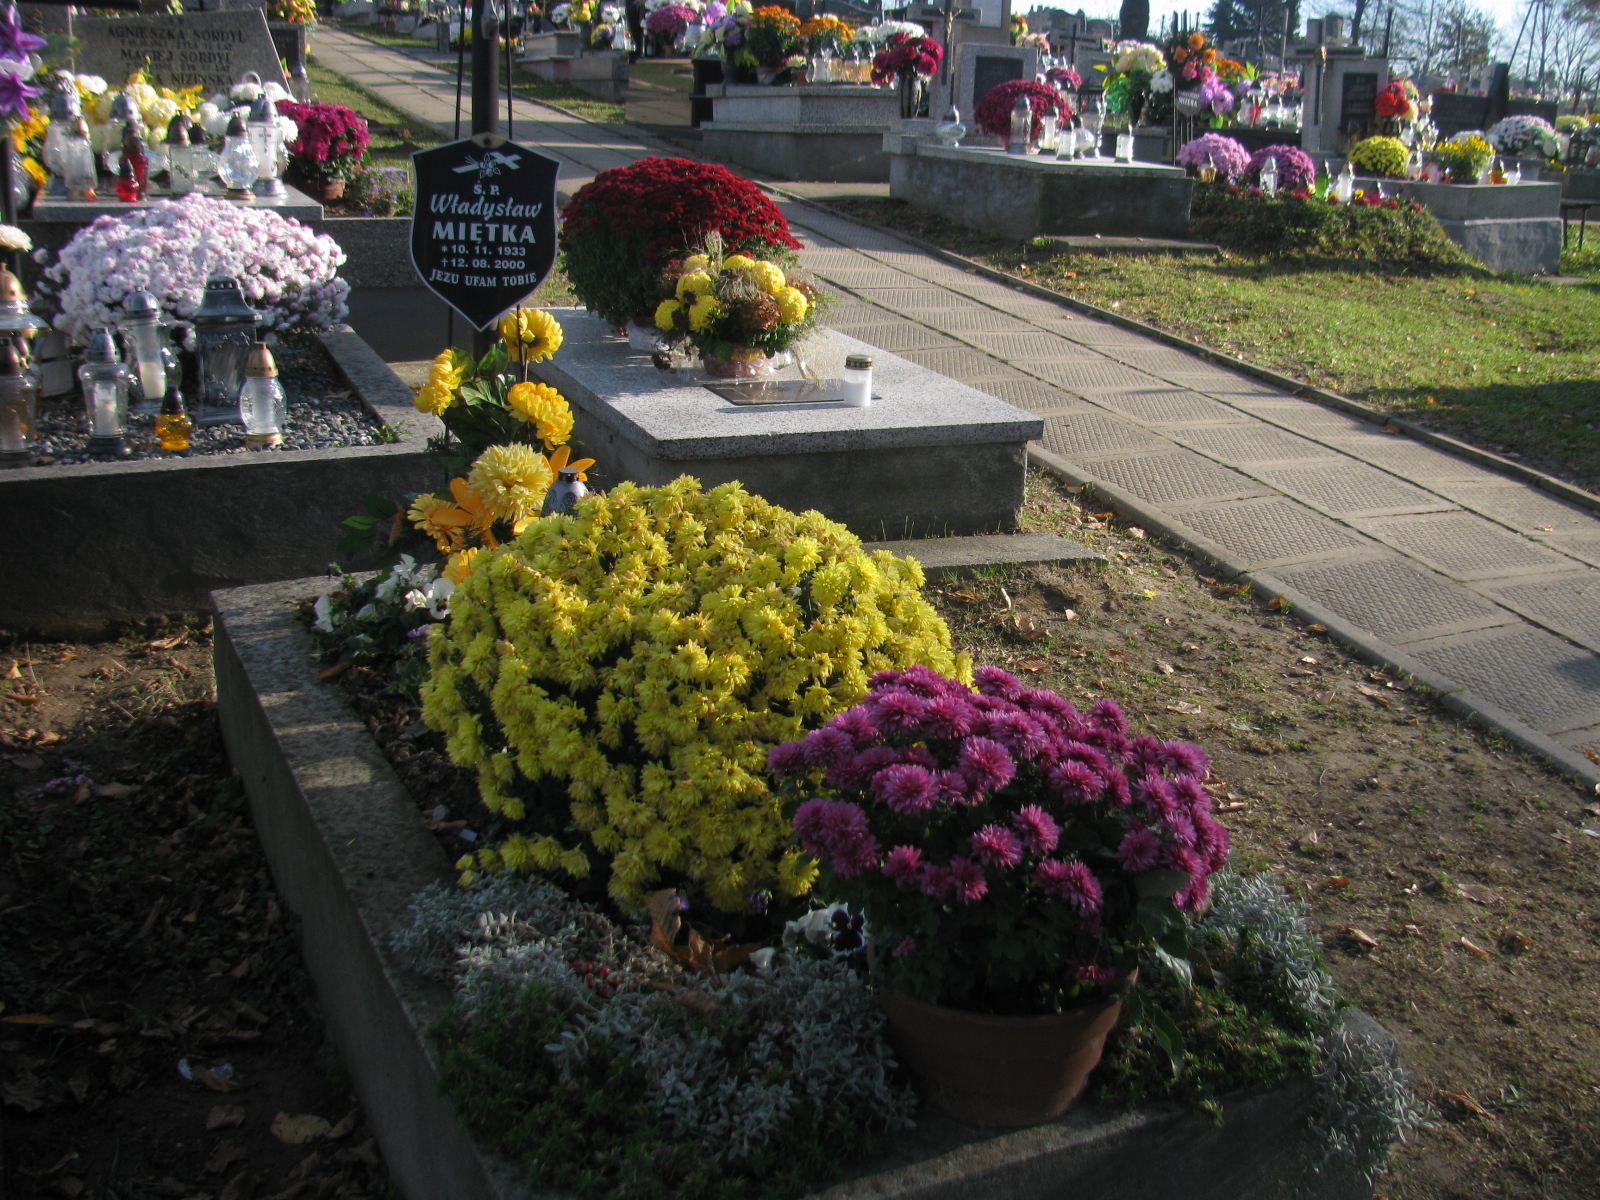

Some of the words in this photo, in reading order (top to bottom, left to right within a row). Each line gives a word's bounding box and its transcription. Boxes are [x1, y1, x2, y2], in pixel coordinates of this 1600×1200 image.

[108, 25, 186, 40] AGNIESZKA
[121, 48, 173, 62] MACIEJ
[430, 193, 542, 221] Władysław
[432, 221, 536, 244] MIĘTKA
[474, 246, 492, 255] 11.
[497, 246, 526, 257] 1933
[472, 259, 491, 269] 08.
[494, 260, 526, 270] 2000
[429, 269, 459, 285] JEZU
[465, 275, 497, 287] UFAM
[503, 272, 537, 287] TOBIE
